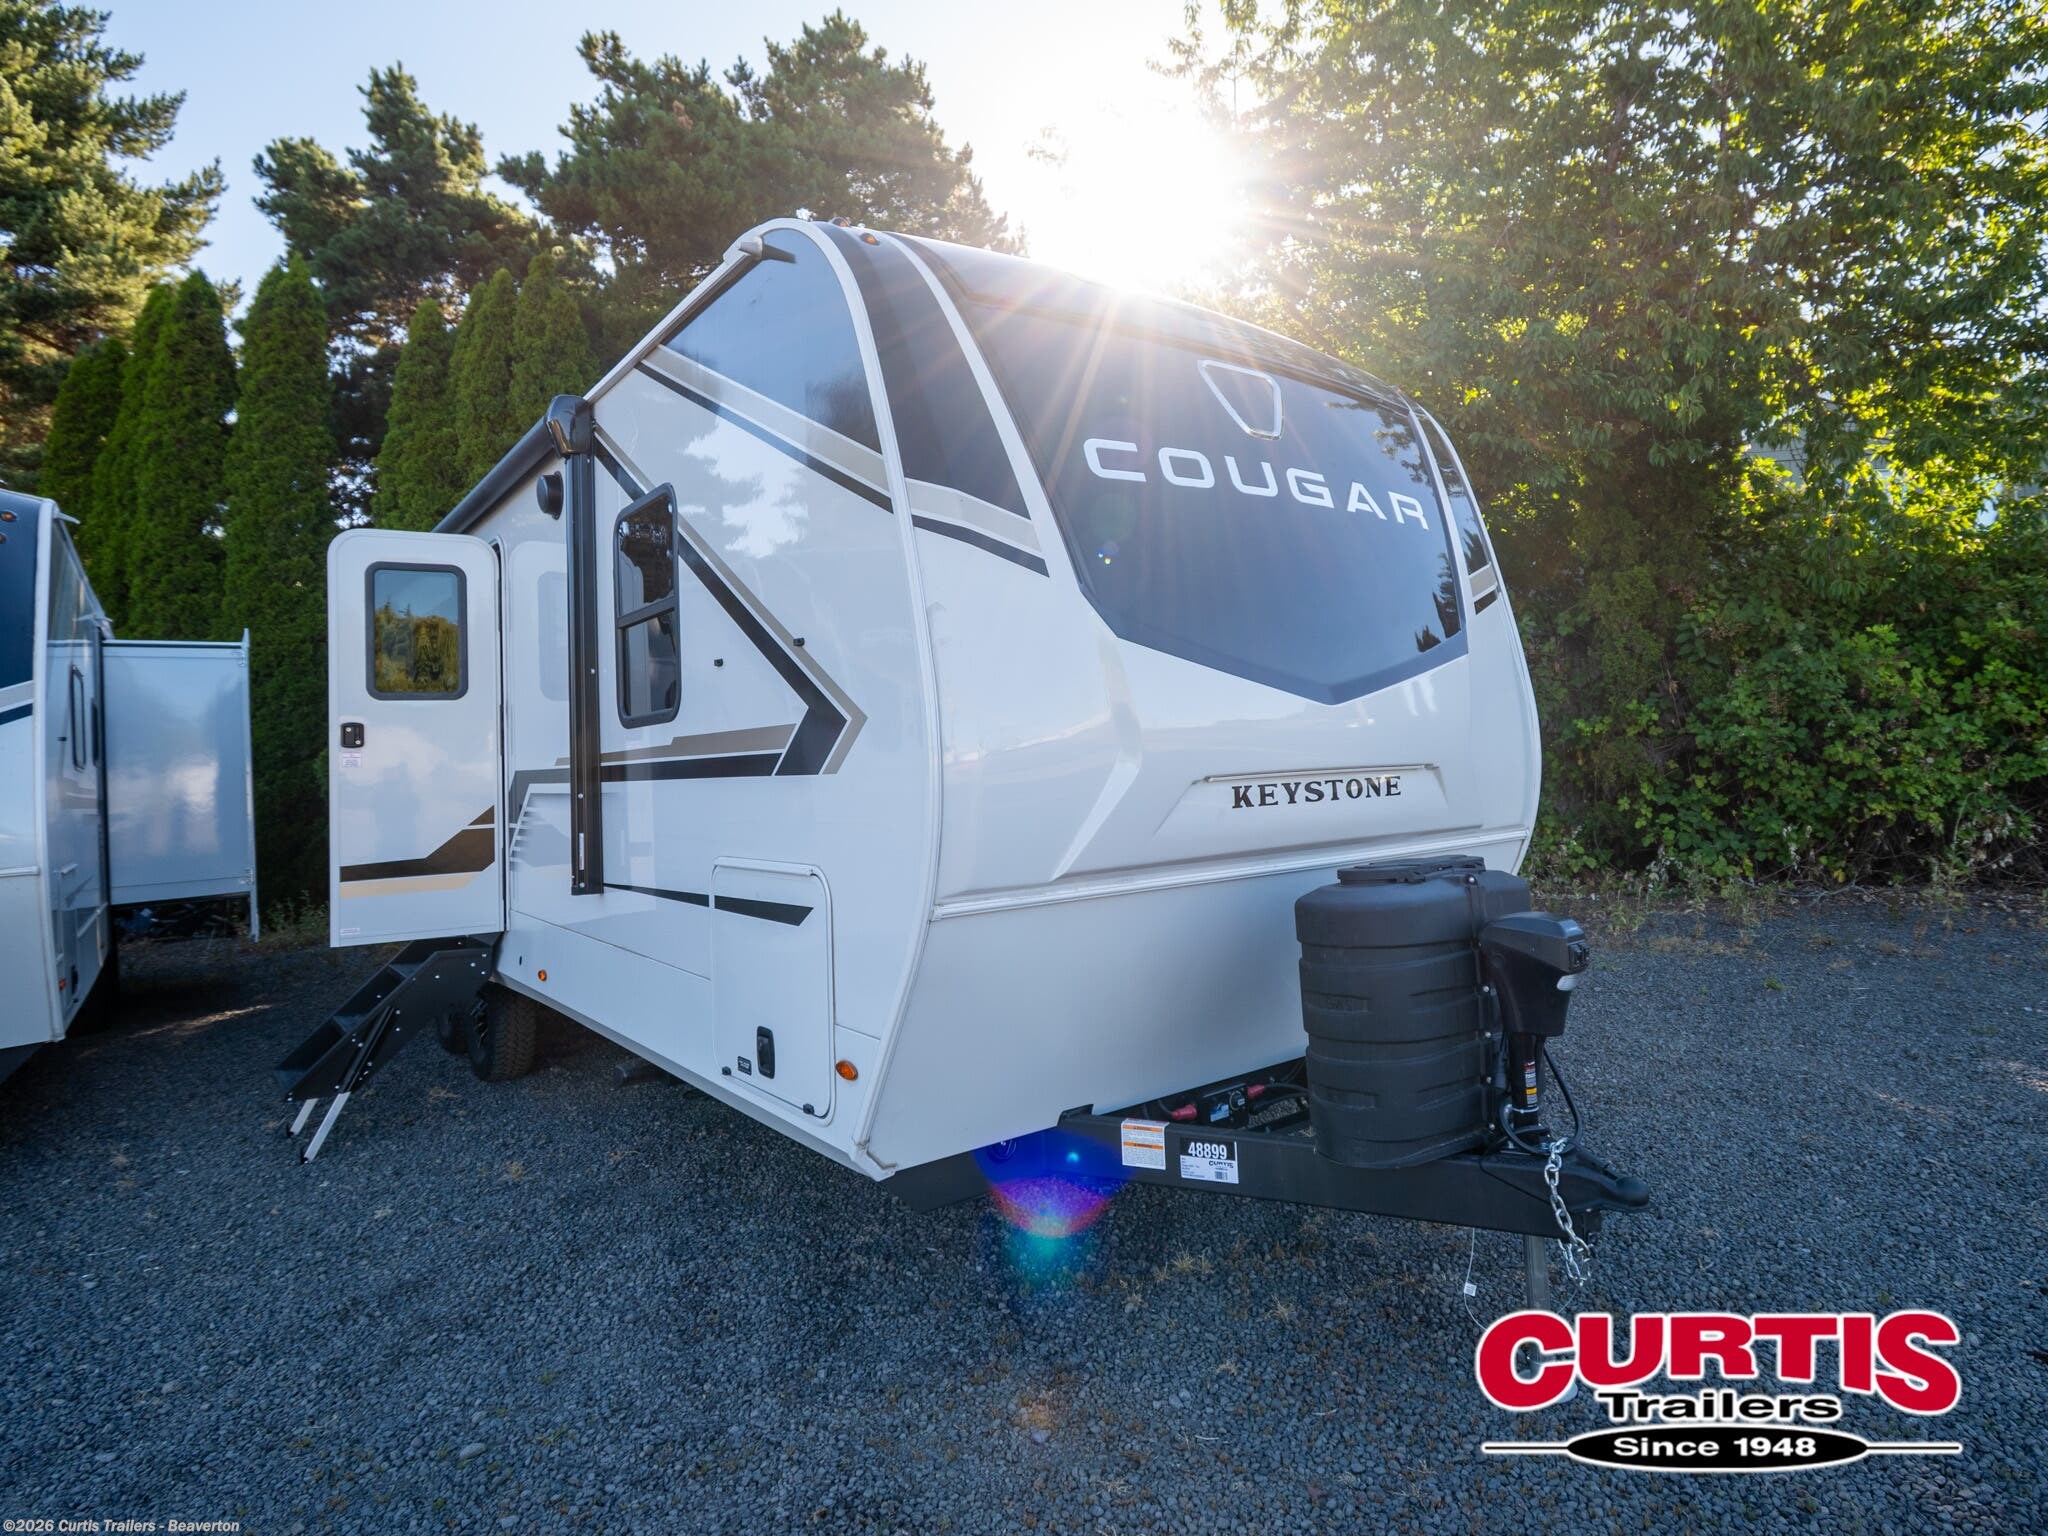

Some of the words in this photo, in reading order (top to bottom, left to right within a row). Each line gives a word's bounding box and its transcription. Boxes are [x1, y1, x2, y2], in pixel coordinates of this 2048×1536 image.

[1083, 438, 1429, 530] COUGAR
[1232, 775, 1402, 809] KEYSTONE
[1188, 1141, 1228, 1160] 48899
